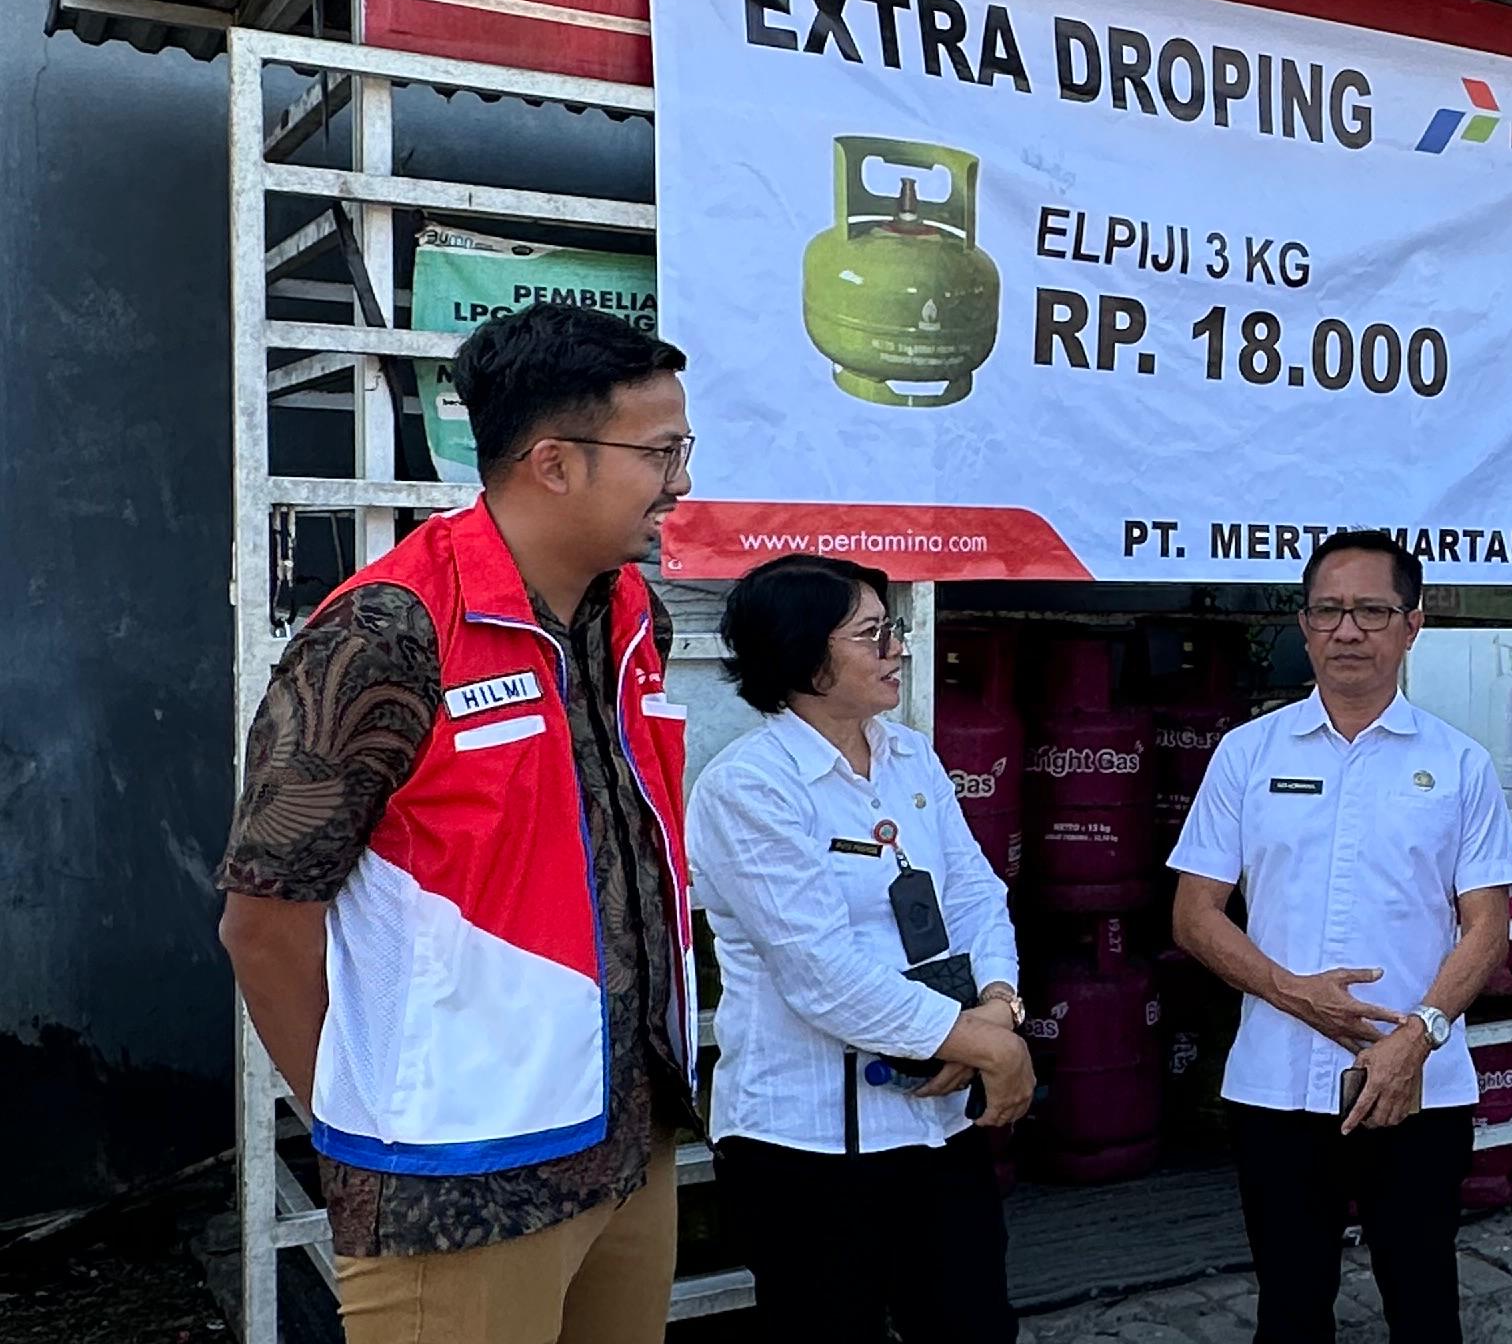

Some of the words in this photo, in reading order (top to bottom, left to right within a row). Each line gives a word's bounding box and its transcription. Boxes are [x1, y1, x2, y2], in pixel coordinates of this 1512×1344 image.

[1054, 16, 1373, 150] DROPING
[1036, 205, 1190, 275] ELPIJI
[1205, 232, 1231, 279] 3
[1245, 236, 1311, 288] KG
[1033, 286, 1156, 375] RP.
[1191, 305, 1449, 398] 18.000
[740, 528, 987, 555] www.pertamina.com
[1123, 519, 1186, 558] PT.
[1210, 522, 1347, 560] MERT
[461, 677, 528, 710] HILMI
[1095, 748, 1140, 773] Gas
[949, 770, 996, 798] Gas
